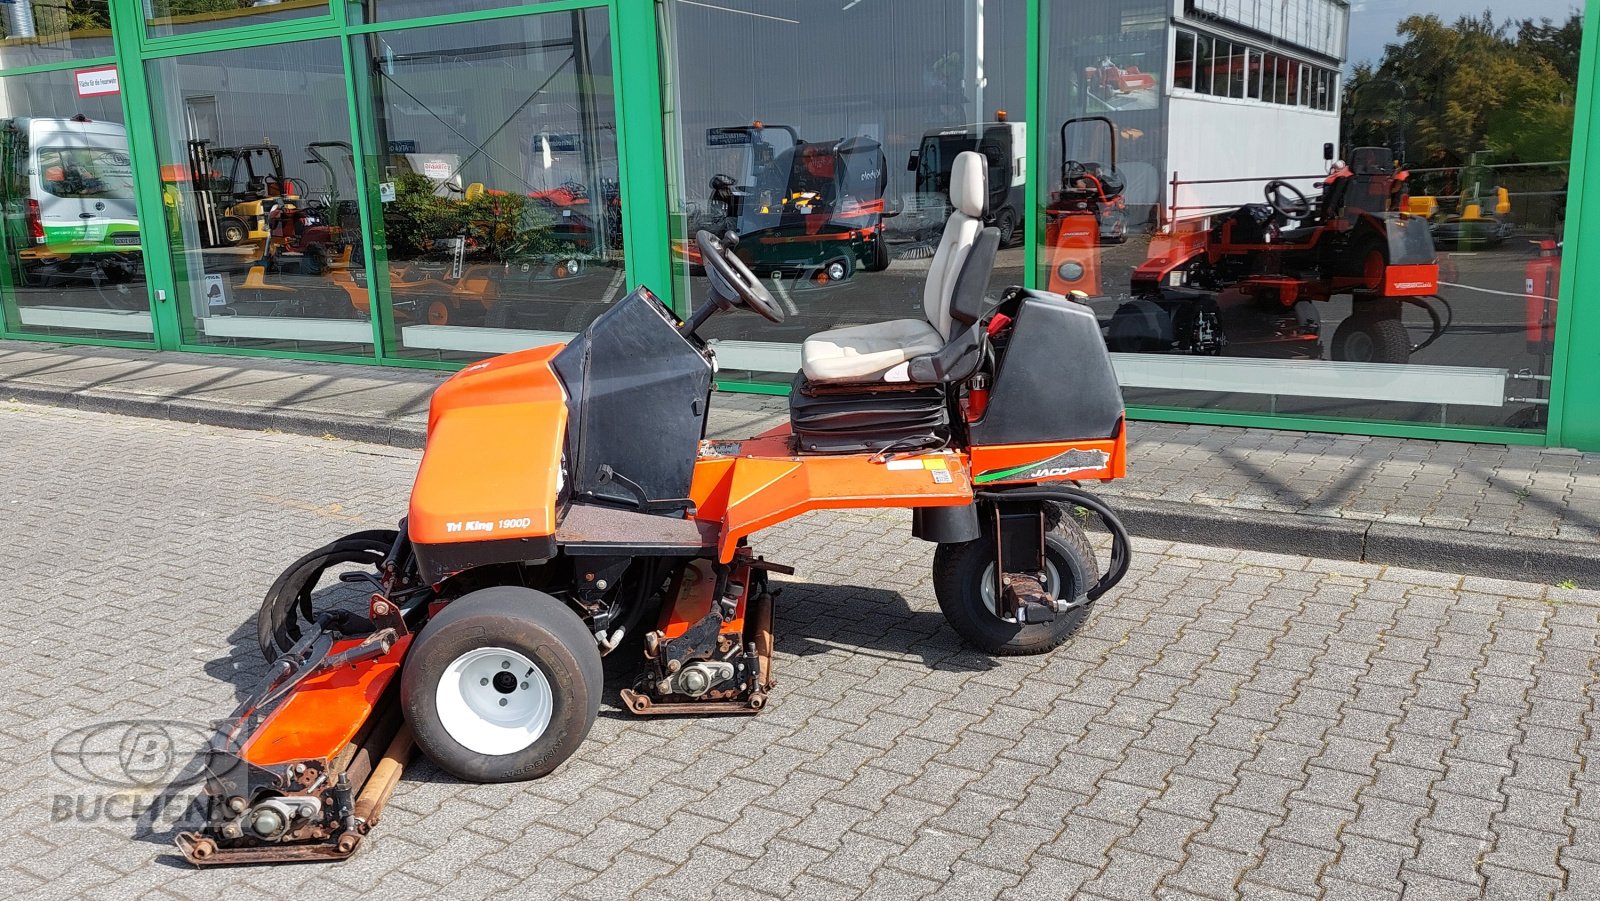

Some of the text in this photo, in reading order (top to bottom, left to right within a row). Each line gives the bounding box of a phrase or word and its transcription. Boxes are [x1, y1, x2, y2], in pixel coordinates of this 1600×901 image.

[446, 517, 531, 533] Tri King 1900D
